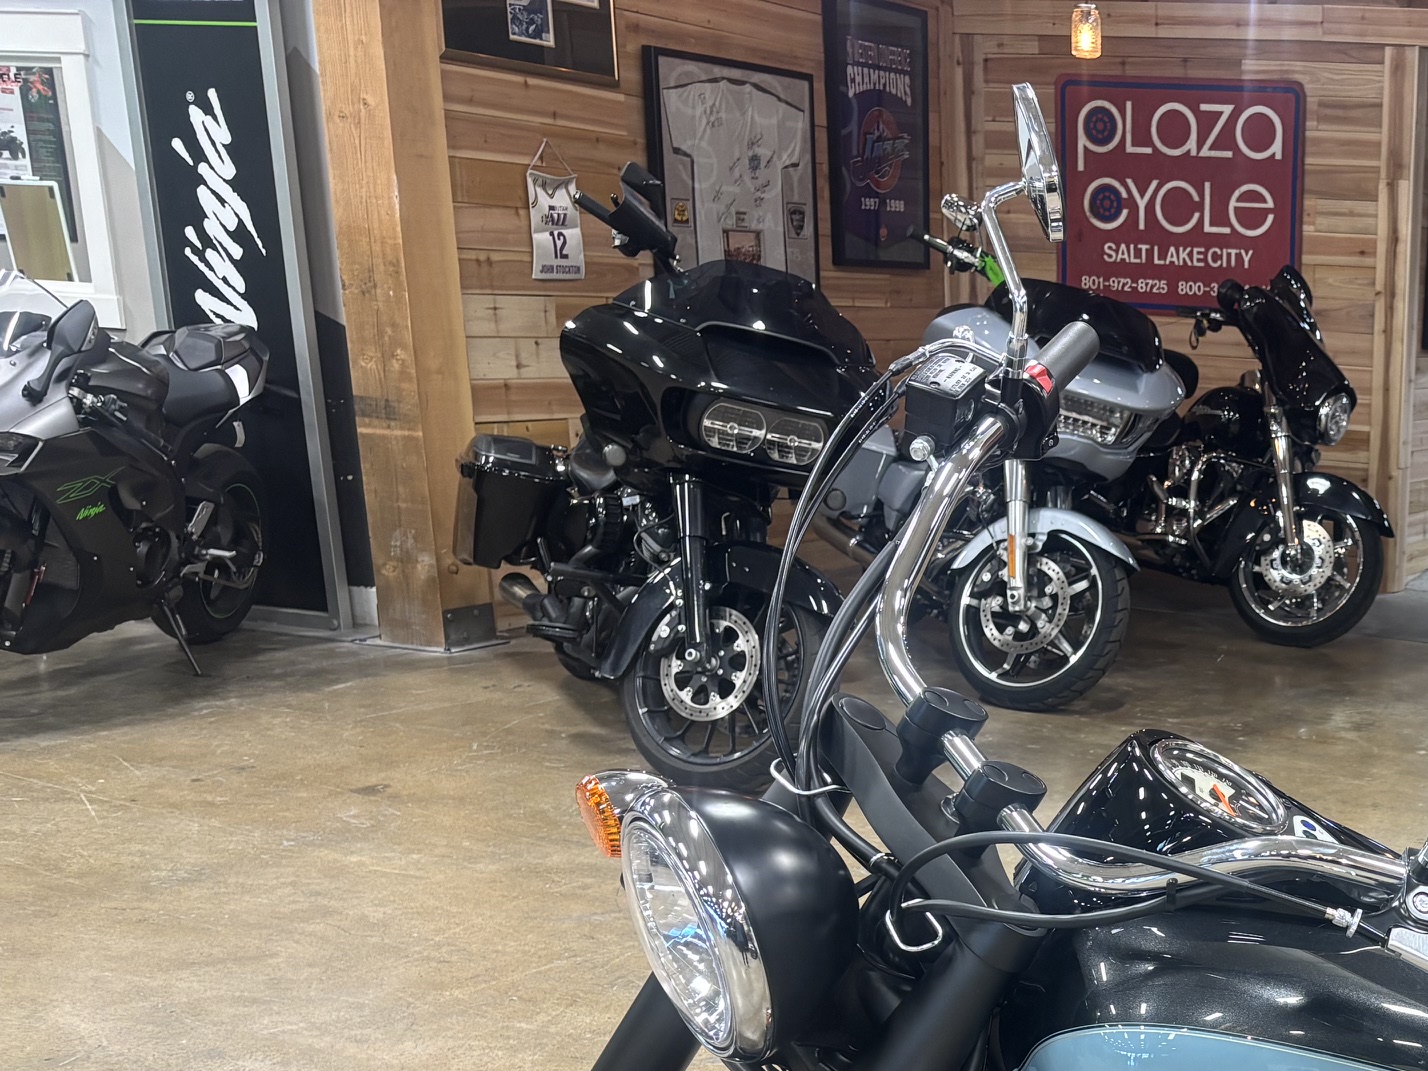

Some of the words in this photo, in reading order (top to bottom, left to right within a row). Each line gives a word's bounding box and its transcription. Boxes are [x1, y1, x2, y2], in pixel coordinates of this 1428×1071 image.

[846, 64, 912, 107] CHAMPIONS
[171, 88, 266, 331] Ninja
[861, 197, 879, 211] 1997
[549, 230, 569, 260] 12
[1103, 242, 1150, 264] SALT
[1153, 245, 1205, 267] LAKE
[1207, 247, 1253, 269] CITY
[540, 264, 555, 275] JOHN
[555, 264, 581, 275] STOCKTON
[1081, 275, 1168, 294] 801-972-8725
[56, 465, 126, 504] ZX
[76, 502, 106, 520] Ninja
